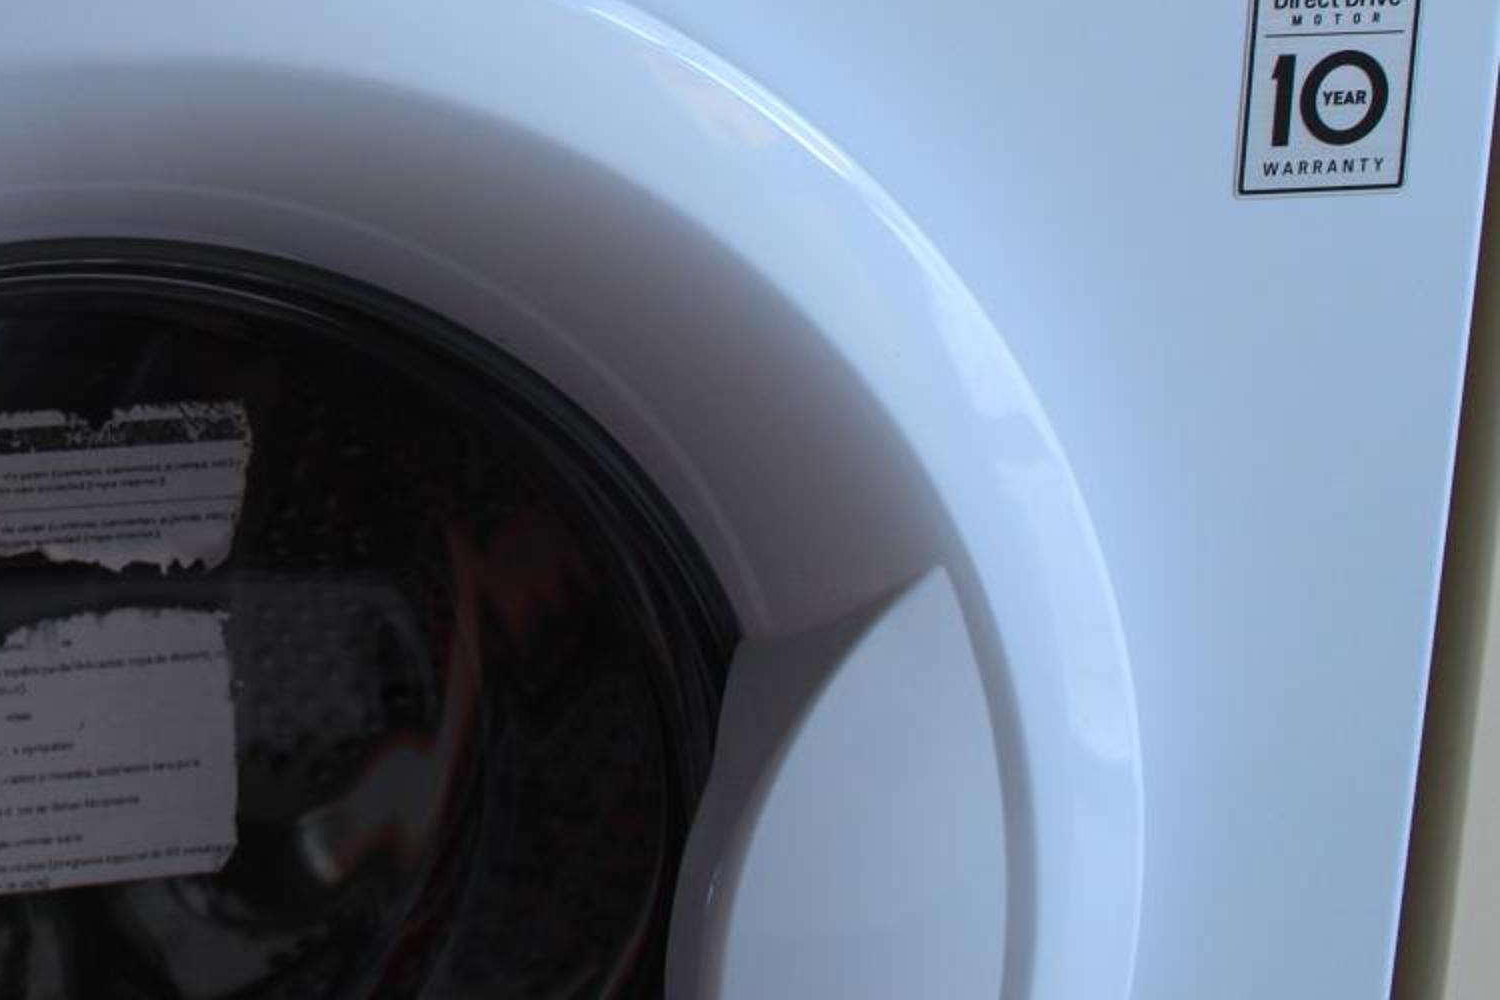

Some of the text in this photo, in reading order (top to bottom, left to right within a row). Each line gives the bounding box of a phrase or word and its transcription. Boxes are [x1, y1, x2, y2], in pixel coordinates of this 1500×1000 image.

[1292, 12, 1380, 26] MOTOR
[1271, 50, 1388, 147] 10
[1323, 90, 1366, 106] YEAR
[1263, 158, 1383, 176] WARRANTY
